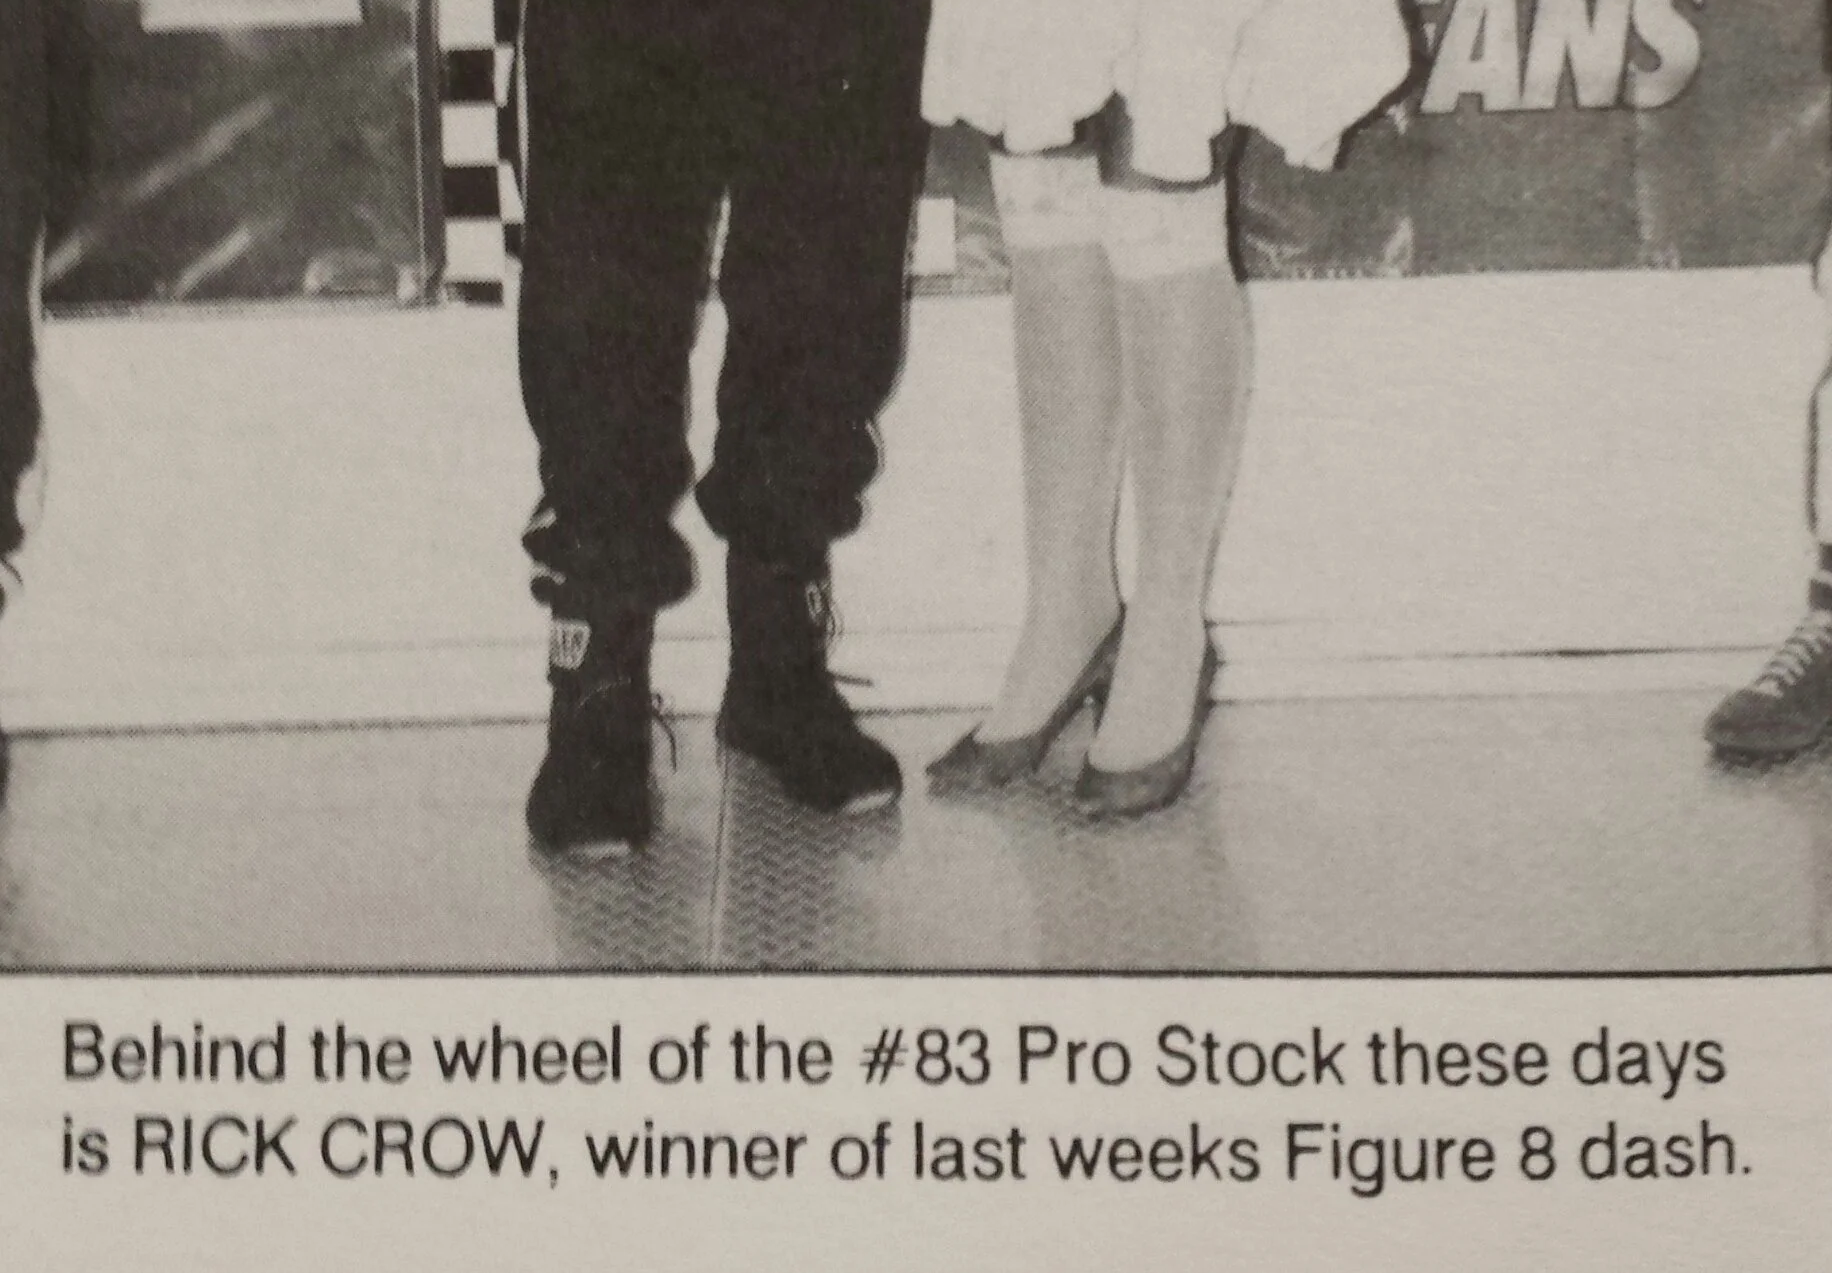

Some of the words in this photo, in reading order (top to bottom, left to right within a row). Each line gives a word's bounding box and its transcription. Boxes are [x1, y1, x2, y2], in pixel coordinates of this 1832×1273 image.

[64, 1021, 286, 1084] Behind
[310, 1023, 411, 1084] the
[433, 1023, 621, 1085] wheel
[649, 1023, 710, 1084] of
[730, 1024, 833, 1085] the
[860, 1027, 990, 1086] #83
[1017, 1024, 1131, 1086] Pro
[1157, 1024, 1346, 1087] Stock
[1366, 1027, 1549, 1087] these
[1572, 1026, 1726, 1100] days
[63, 1114, 109, 1176] is
[135, 1115, 297, 1177] RICK
[320, 1116, 558, 1189] CROW,
[585, 1119, 807, 1181] winner
[830, 1120, 891, 1180] of
[914, 1120, 1026, 1181] last
[1049, 1122, 1260, 1182] weeks
[1286, 1122, 1495, 1198] Figure
[1519, 1126, 1557, 1181] 8
[1579, 1119, 1752, 1181] dash.
